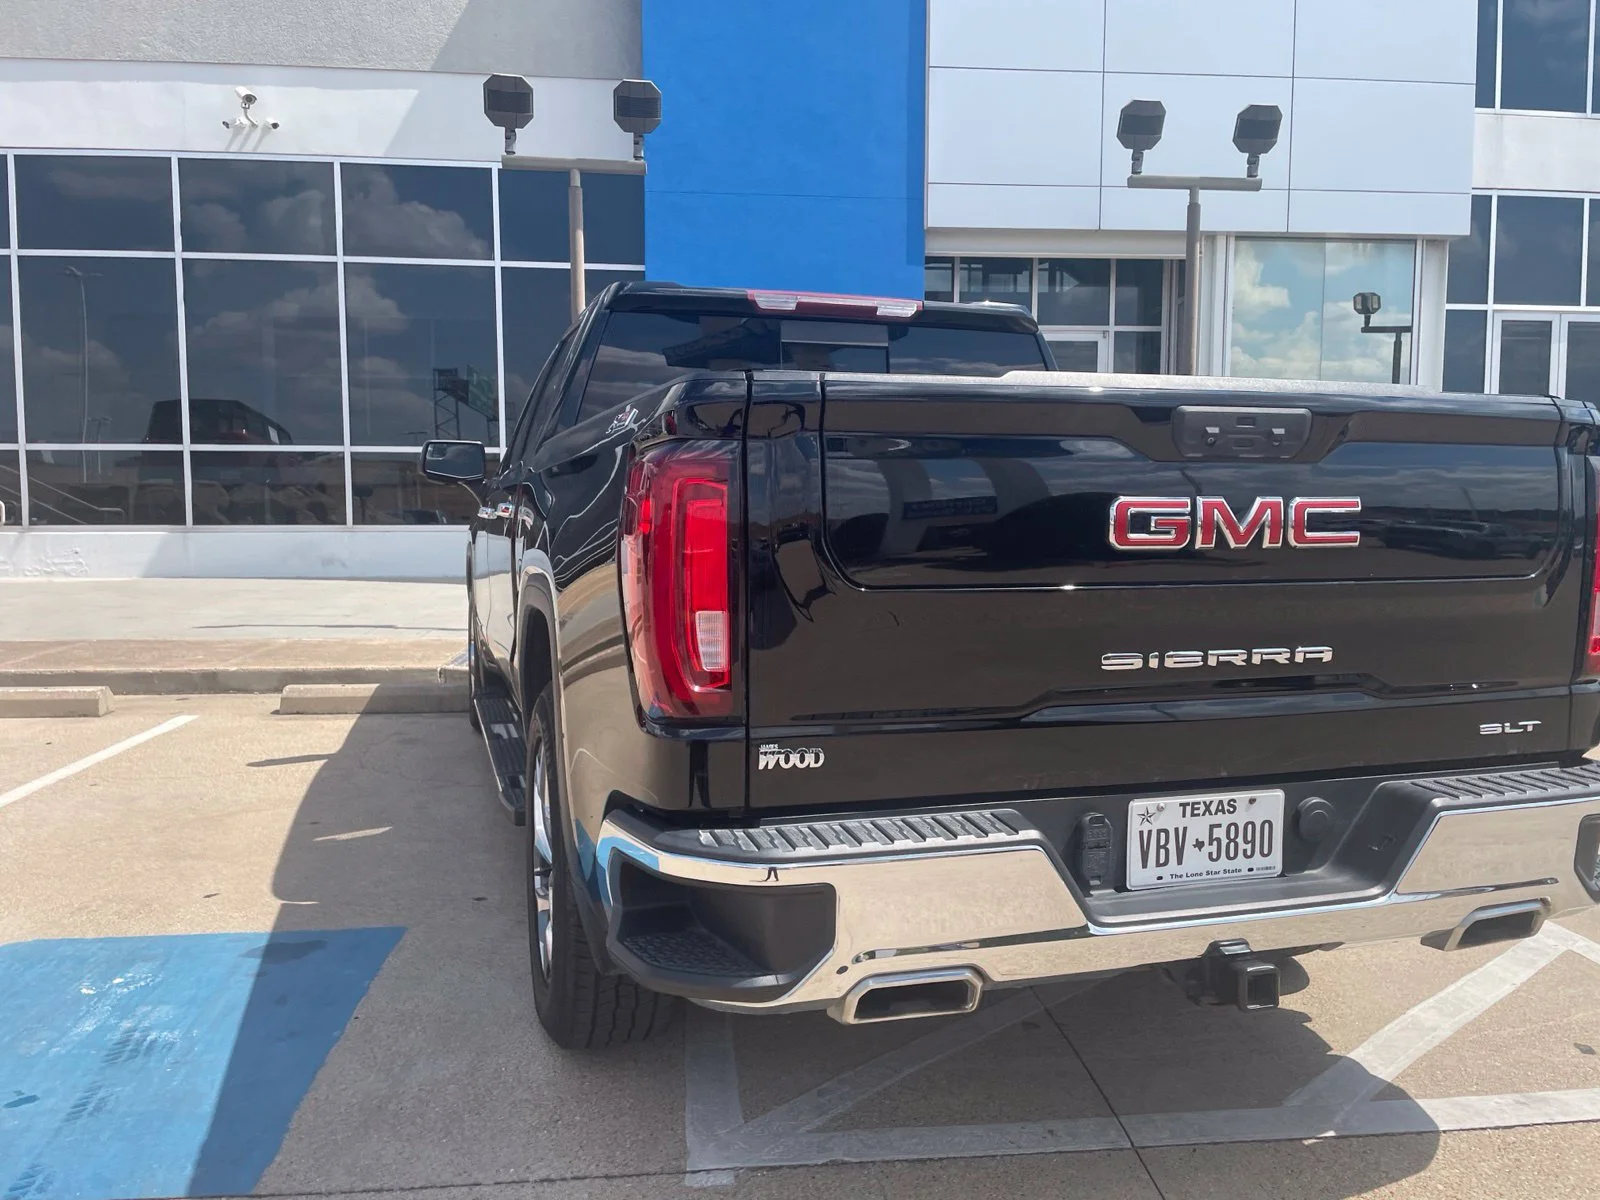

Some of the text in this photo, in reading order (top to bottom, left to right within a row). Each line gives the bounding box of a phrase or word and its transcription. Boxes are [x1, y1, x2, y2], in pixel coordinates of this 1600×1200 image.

[1109, 496, 1361, 550] GMC
[1101, 645, 1333, 671] SIERRA
[1479, 720, 1542, 735] SLT
[758, 748, 825, 770] WOOD
[1179, 799, 1238, 818] TEXAS
